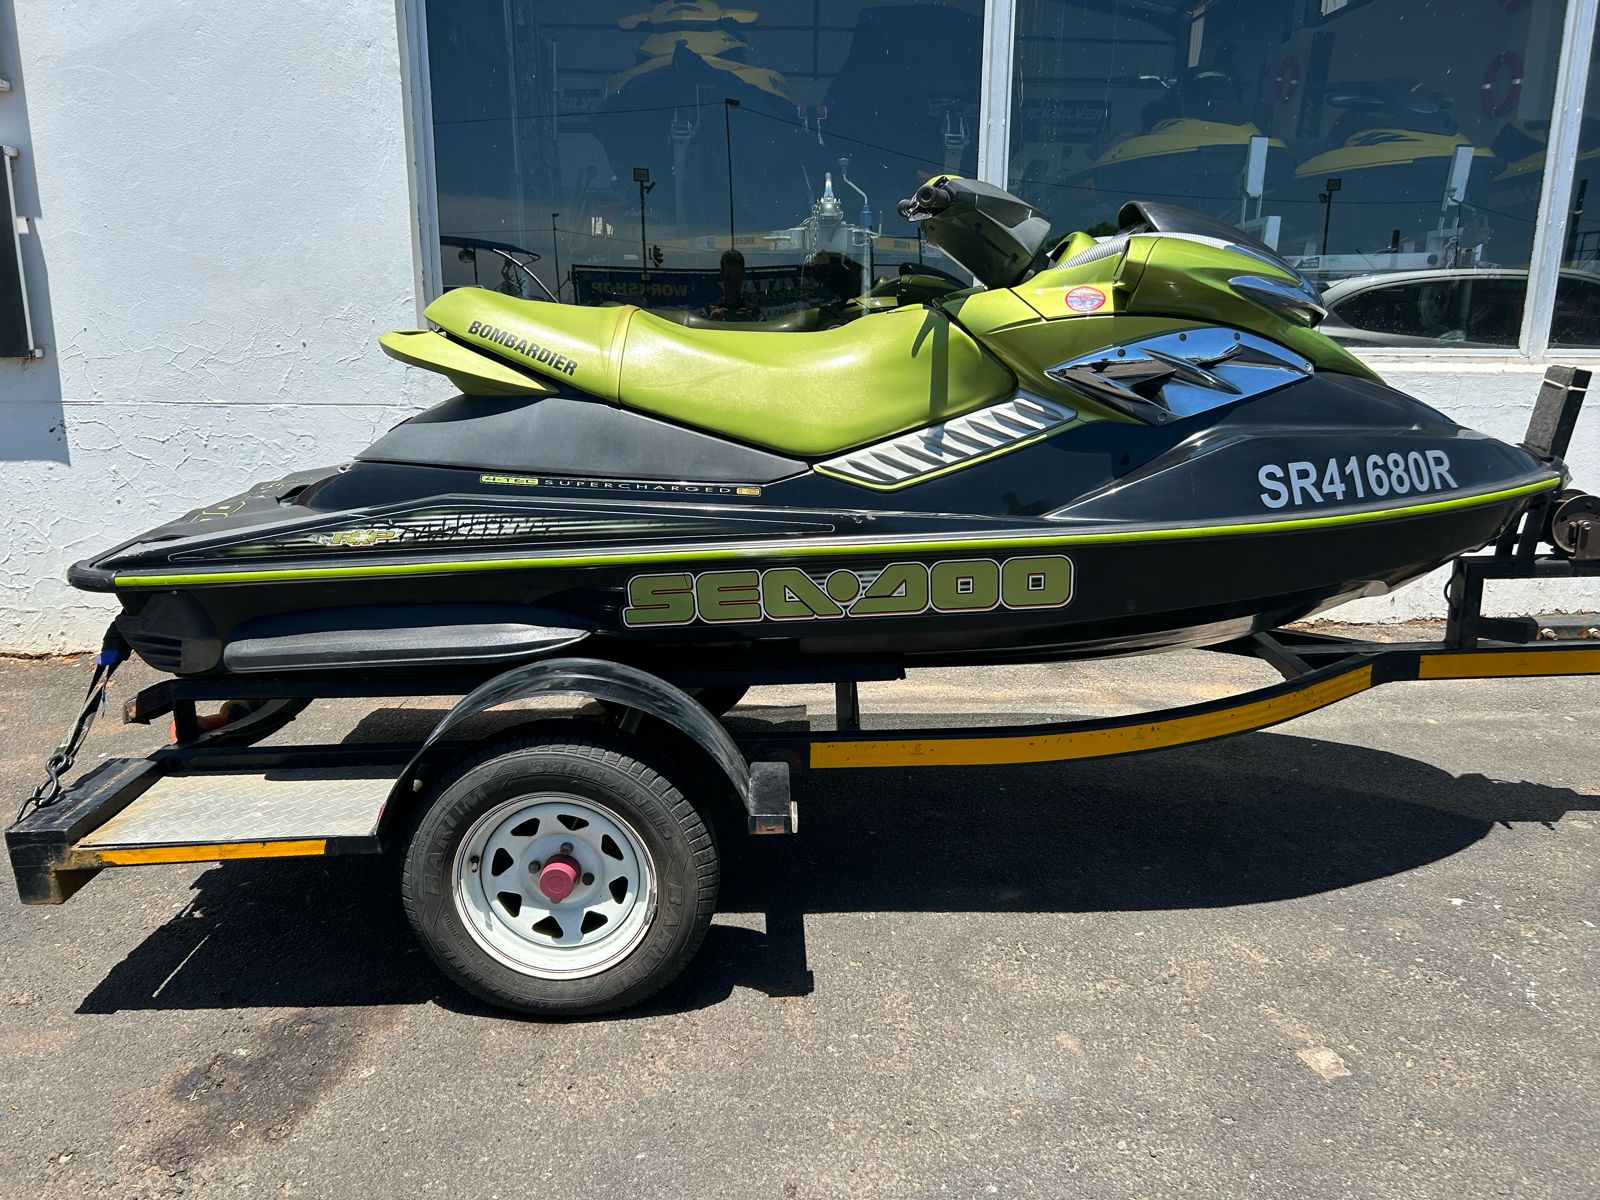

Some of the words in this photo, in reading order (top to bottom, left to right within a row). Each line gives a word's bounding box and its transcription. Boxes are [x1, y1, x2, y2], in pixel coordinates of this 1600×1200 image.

[467, 320, 578, 376] BOMBARDIER
[544, 479, 731, 493] SUPERCHARGED
[1258, 449, 1459, 509] SR41680R
[329, 529, 396, 546] RXP
[423, 787, 489, 896] BARUM
